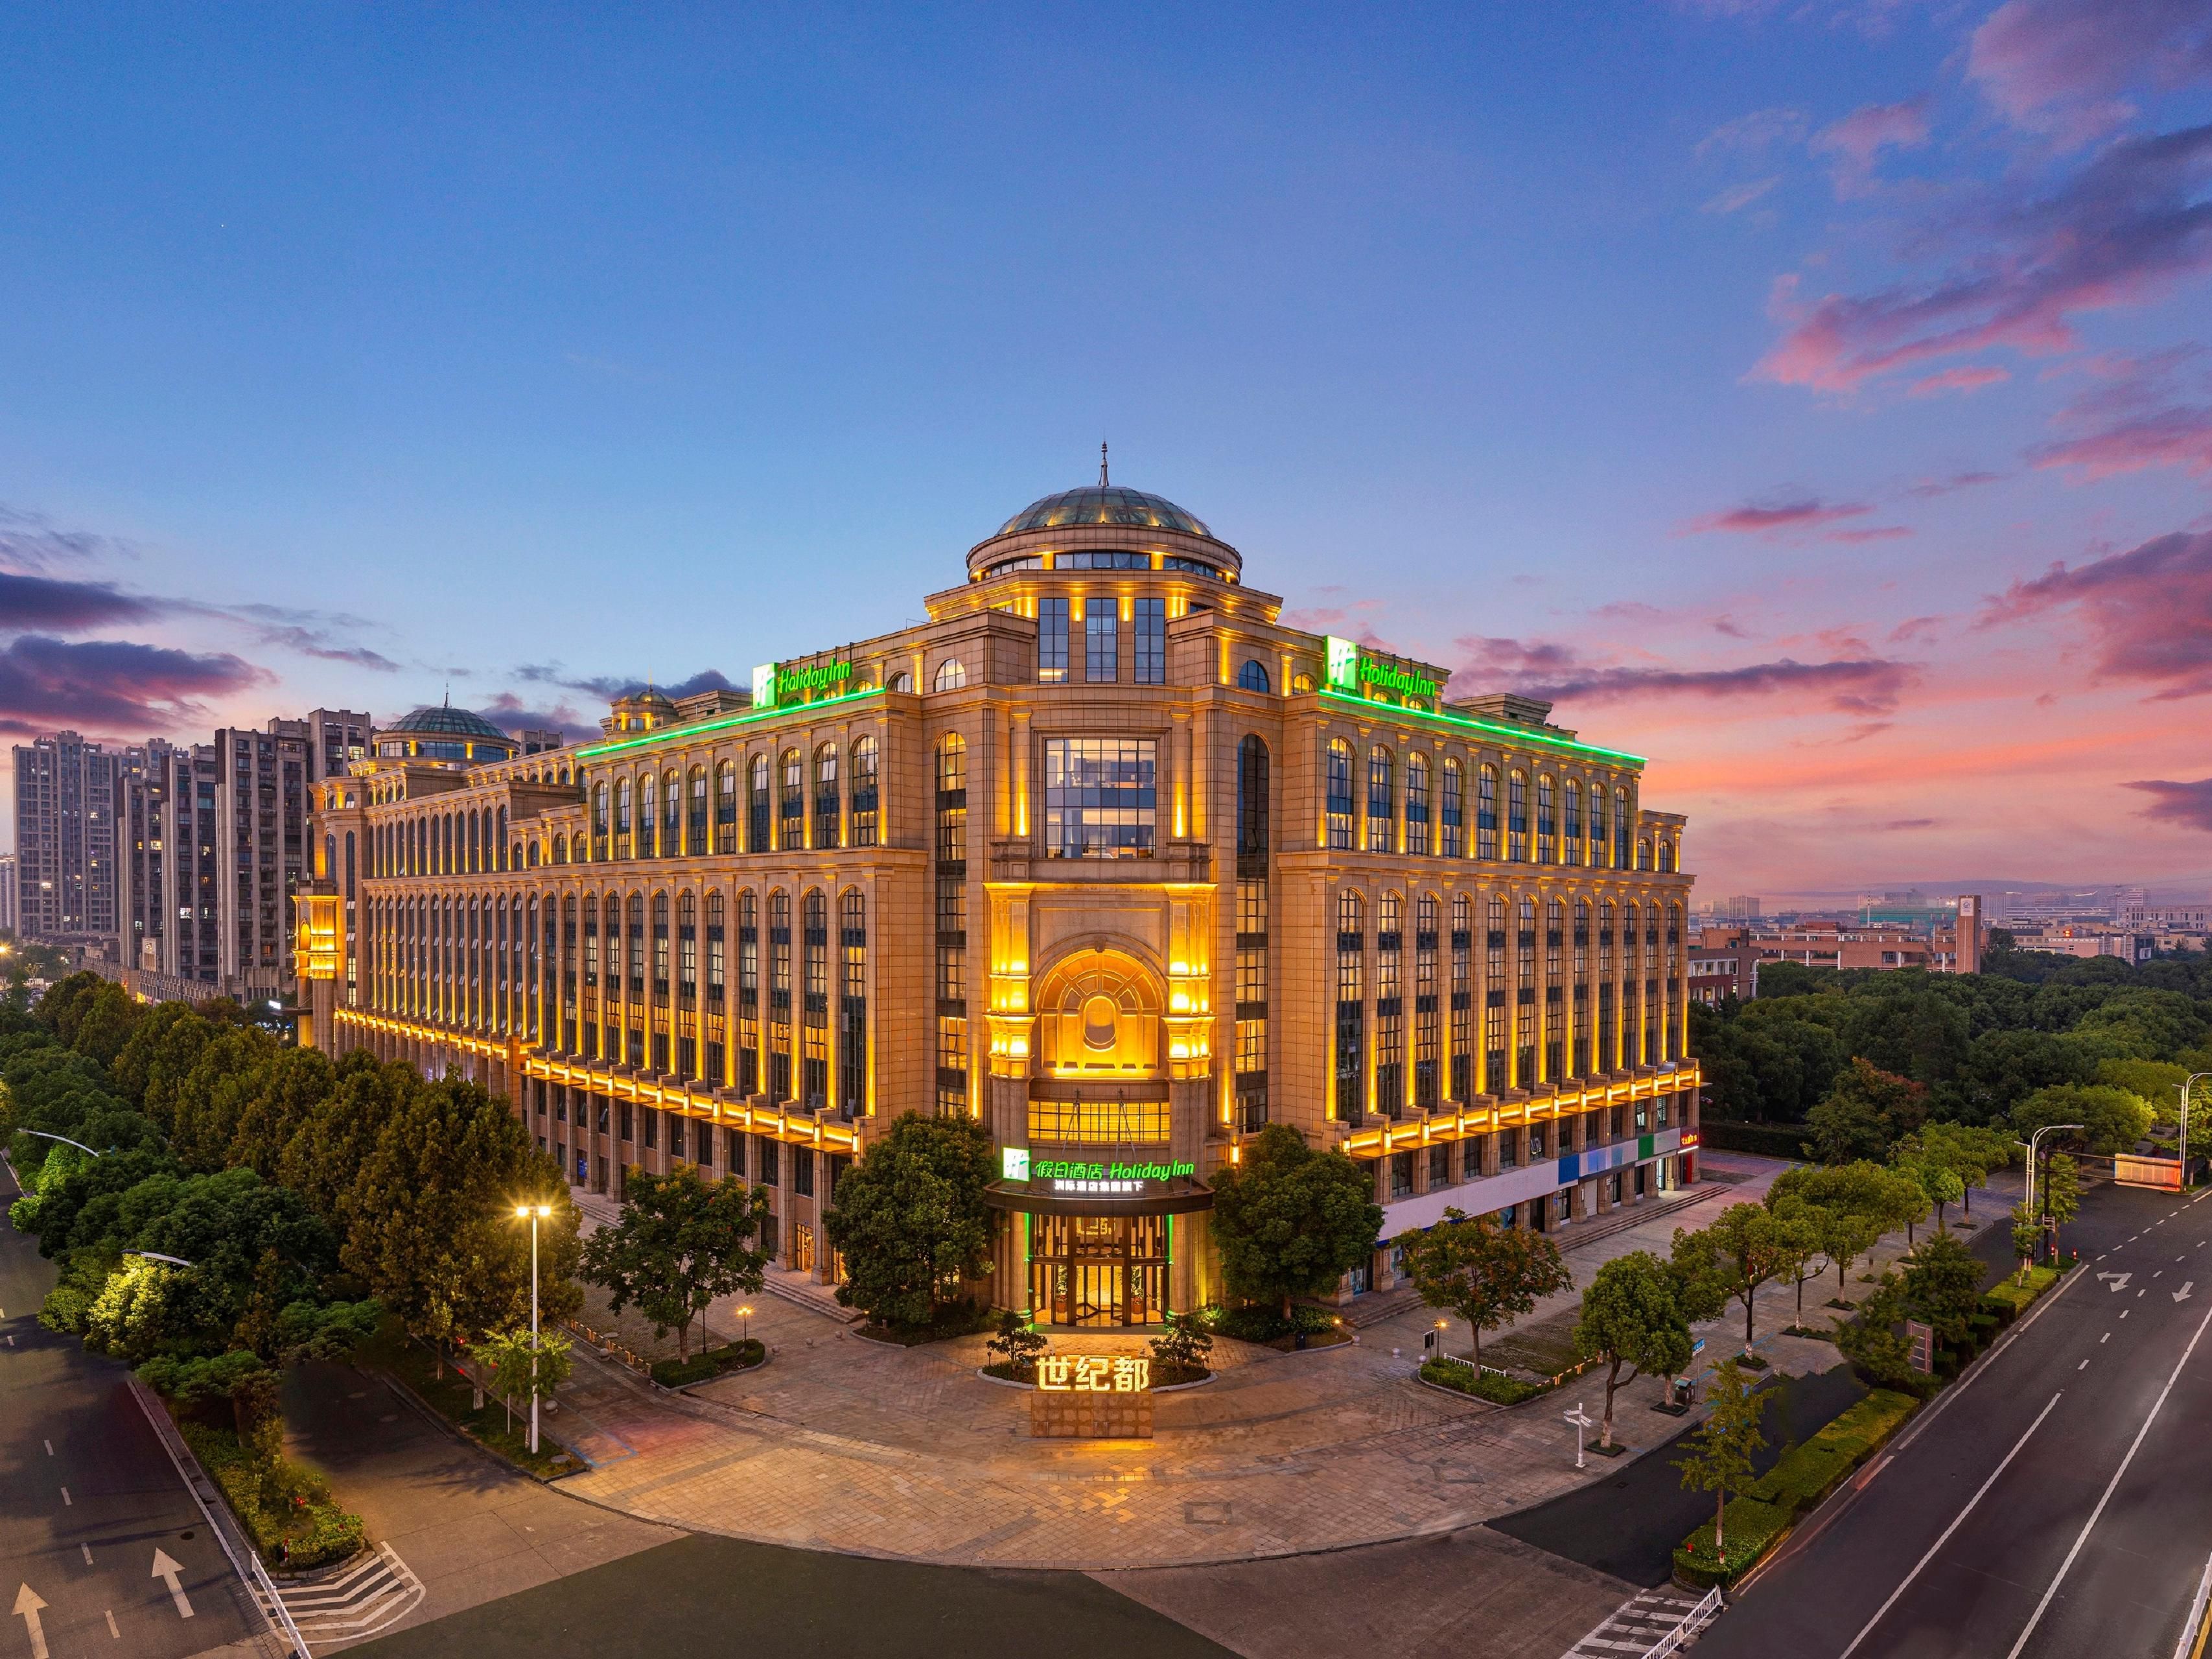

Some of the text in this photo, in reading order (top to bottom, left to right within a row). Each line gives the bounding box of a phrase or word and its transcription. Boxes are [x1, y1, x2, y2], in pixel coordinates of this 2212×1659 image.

[779, 658, 852, 693] Holiday Inn
[1360, 656, 1435, 697] Holiday Inn
[1036, 1161, 1104, 1179] 假日酒店
[1110, 1159, 1194, 1181] Holiday Inn
[1036, 1355, 1149, 1392] 世纪都
